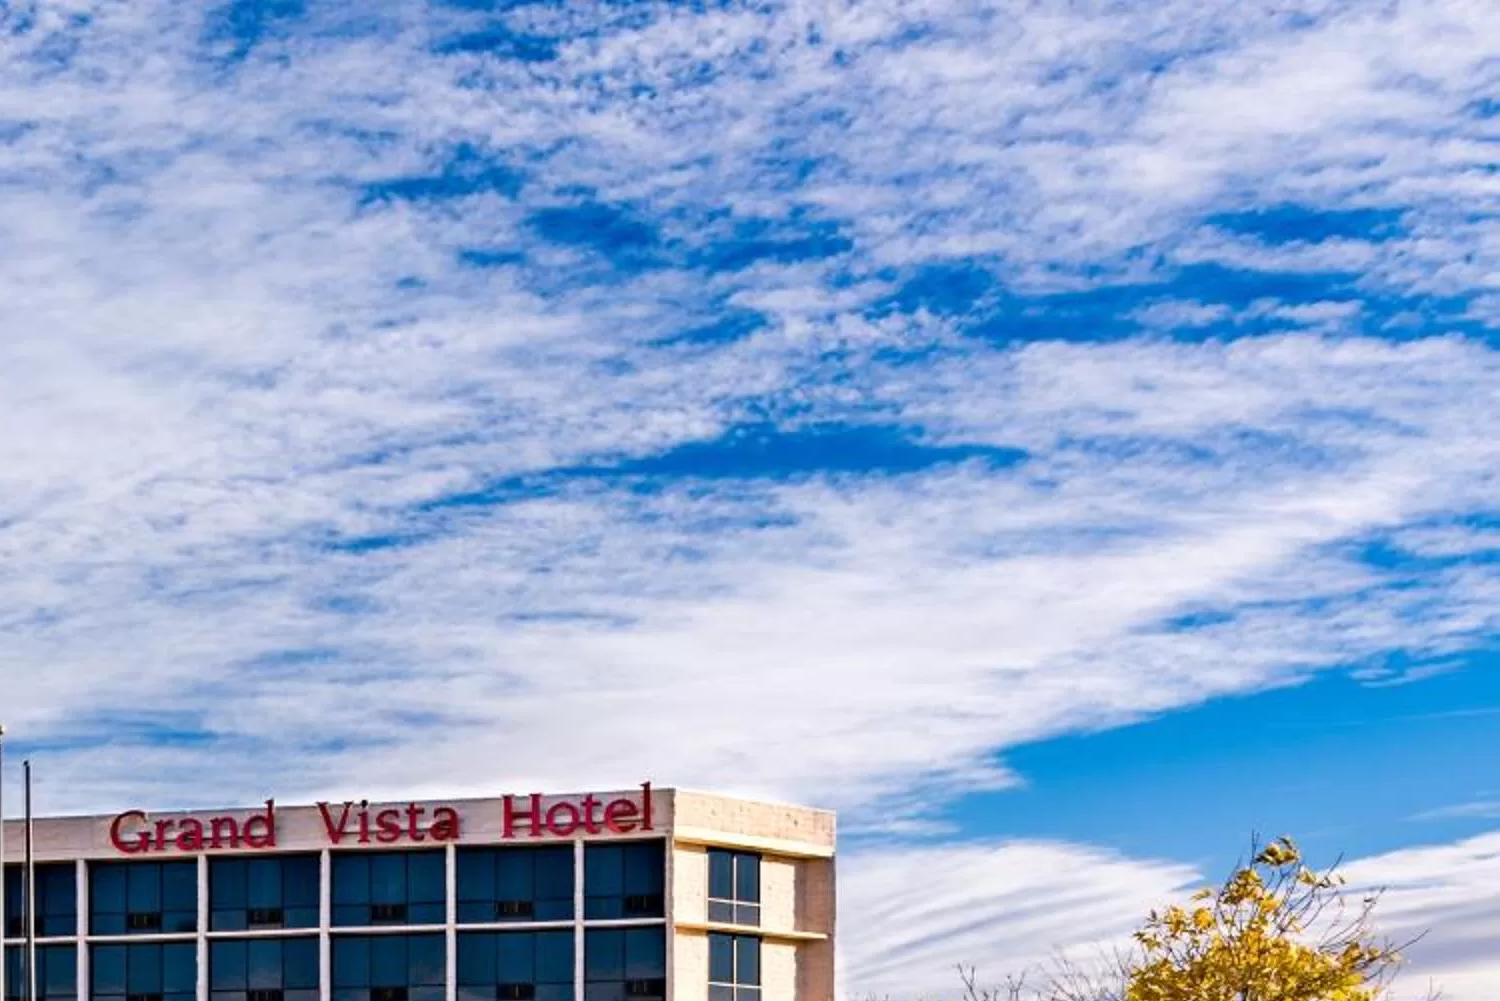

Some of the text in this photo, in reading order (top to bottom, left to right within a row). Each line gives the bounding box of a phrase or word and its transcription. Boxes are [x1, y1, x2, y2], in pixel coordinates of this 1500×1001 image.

[110, 781, 654, 853] Grand Vista Hotel
